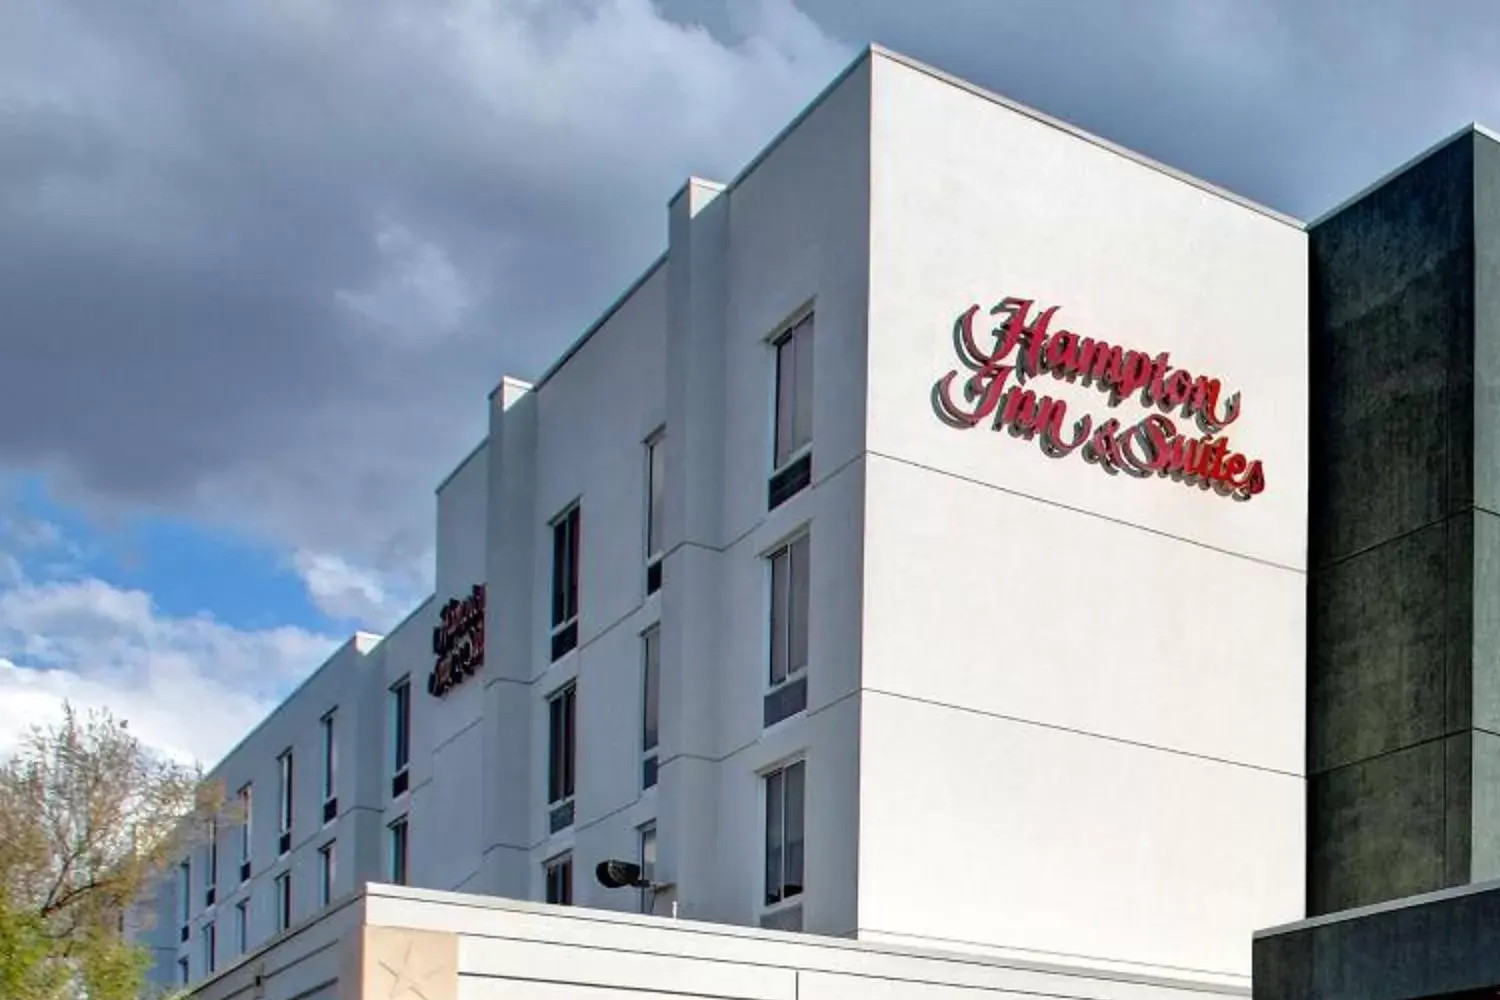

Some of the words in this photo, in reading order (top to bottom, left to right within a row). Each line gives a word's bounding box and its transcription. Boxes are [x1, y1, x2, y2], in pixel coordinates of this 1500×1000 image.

[953, 296, 1240, 432] Hampton
[930, 364, 1091, 458] Inn
[1116, 413, 1265, 501] Suites
